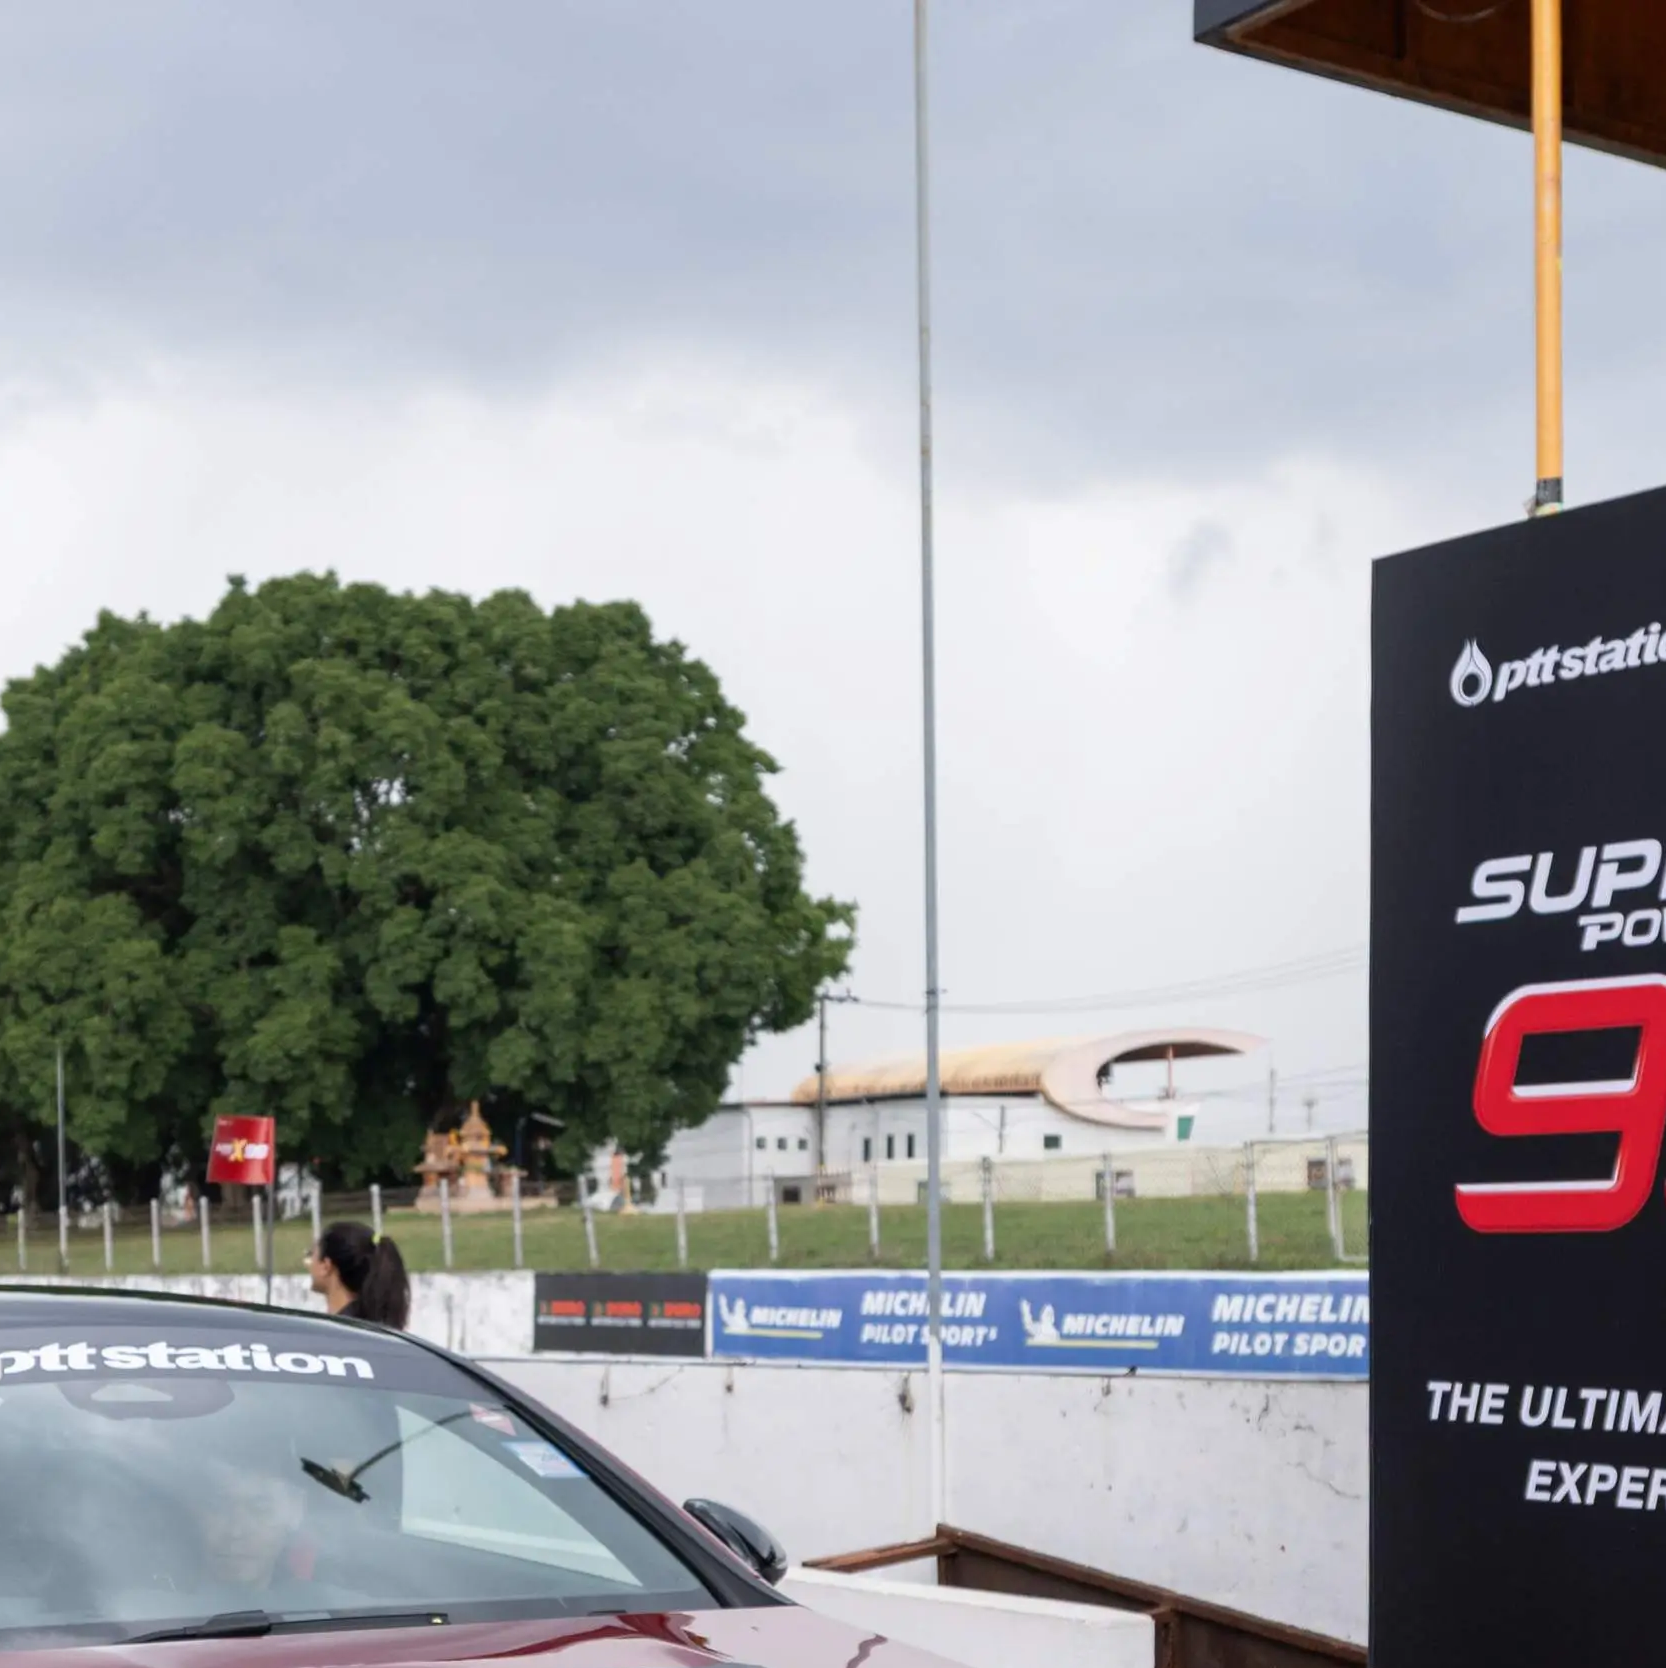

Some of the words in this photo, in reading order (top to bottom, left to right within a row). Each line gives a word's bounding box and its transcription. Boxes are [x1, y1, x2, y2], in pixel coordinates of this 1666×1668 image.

[860, 1289, 987, 1318] MICHLIN
[1212, 1293, 1370, 1324] MICHELIN
[751, 1306, 843, 1330] MICHELIN
[1061, 1314, 1185, 1338] MICHELIN
[860, 1323, 919, 1344] PILOT
[1212, 1331, 1289, 1355] PILOT
[1426, 1380, 1510, 1425] THE
